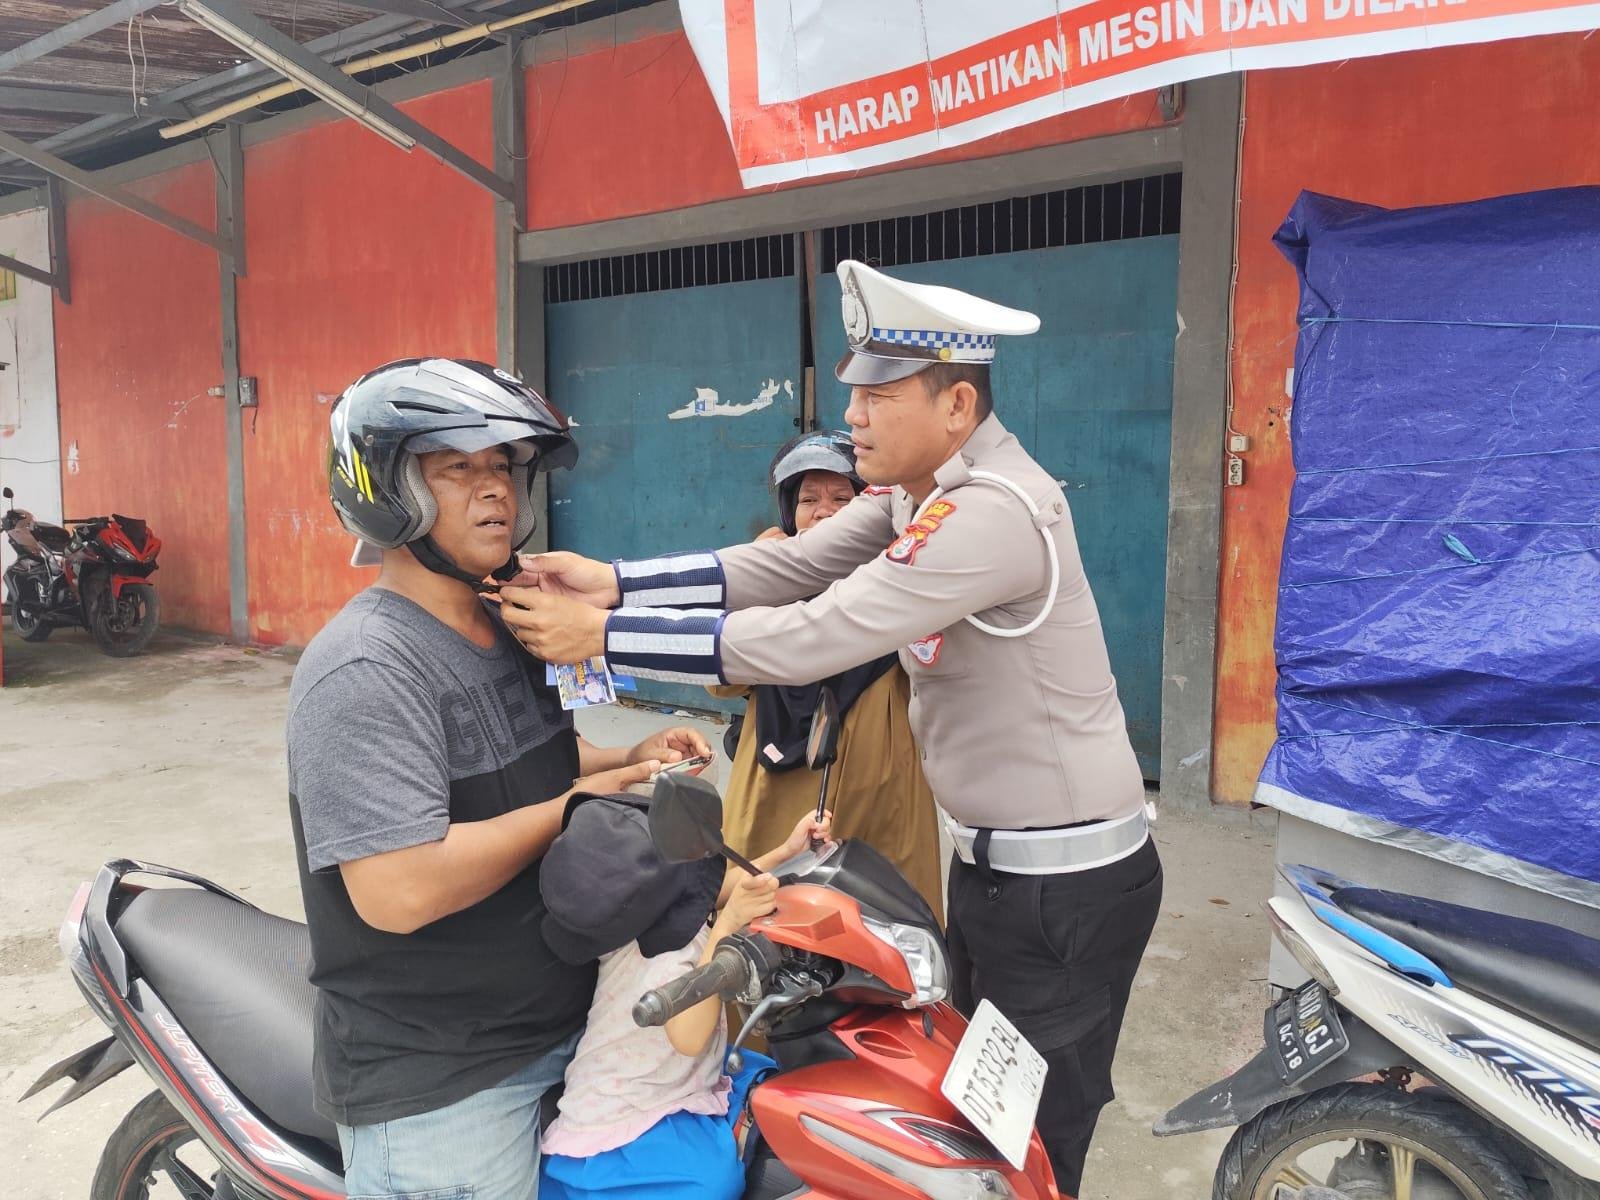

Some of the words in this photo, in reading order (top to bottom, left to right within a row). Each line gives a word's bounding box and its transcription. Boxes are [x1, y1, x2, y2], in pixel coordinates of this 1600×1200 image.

[814, 85, 919, 144] HARAP
[931, 32, 1068, 115] MATIKAN
[1079, 0, 1204, 67] MESIN
[1220, 0, 1308, 33] DAN
[155, 1012, 239, 1113] JUPITER
[991, 1019, 1019, 1053] BL
[973, 1037, 1012, 1098] 5332
[962, 1079, 995, 1124] DT
